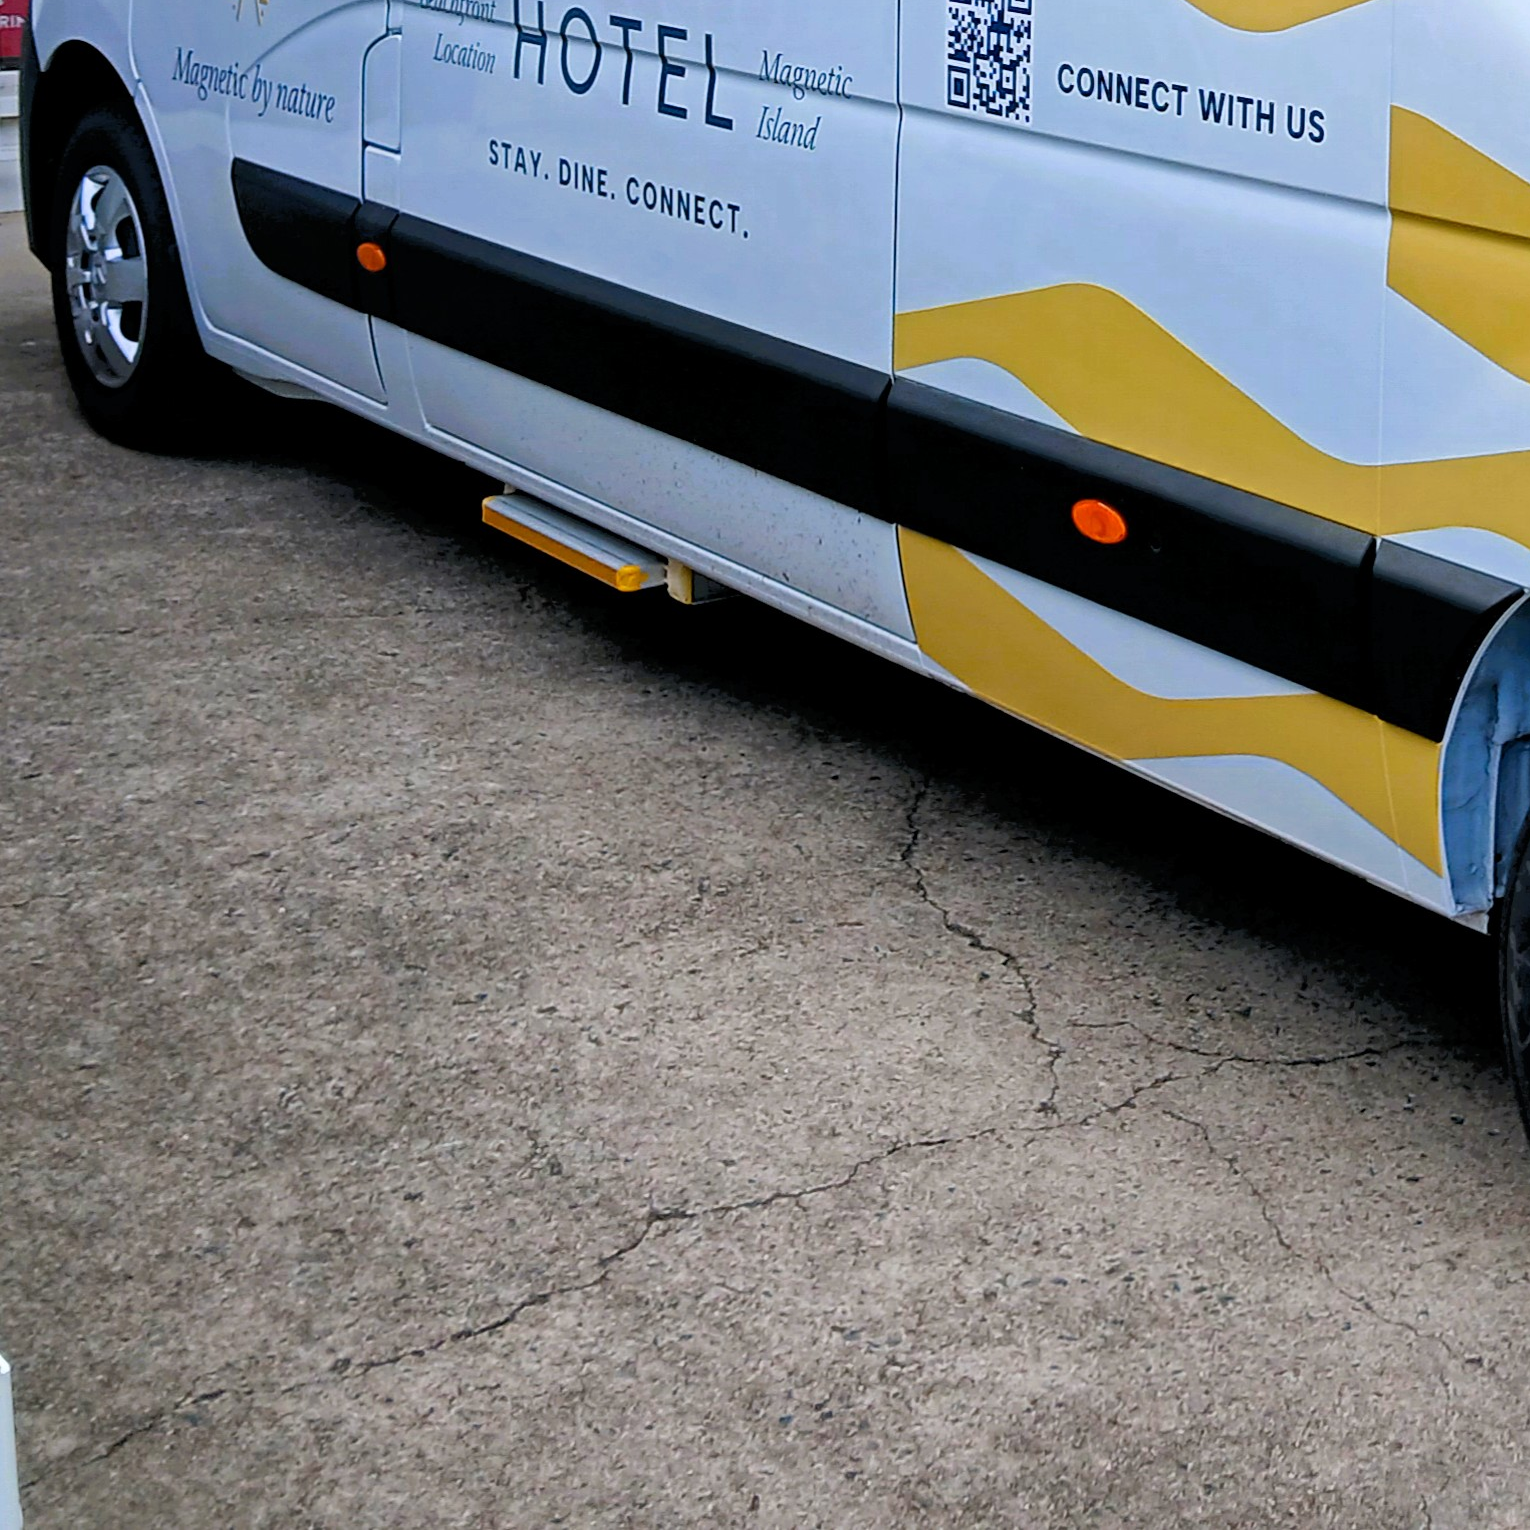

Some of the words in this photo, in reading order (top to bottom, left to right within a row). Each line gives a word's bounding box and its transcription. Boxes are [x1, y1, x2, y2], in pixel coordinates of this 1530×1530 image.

[171, 46, 249, 101] Magnetic
[251, 64, 272, 117] by
[276, 79, 336, 123] nature
[433, 32, 496, 75] Location
[757, 49, 854, 101] Magnetic
[755, 104, 822, 151] Island
[1056, 63, 1188, 116] CONNECT
[1197, 87, 1275, 134] WITH
[1286, 104, 1326, 144] US
[488, 138, 549, 181] STAY.
[558, 157, 616, 200] DINE.
[626, 176, 749, 239] CONNECT.
